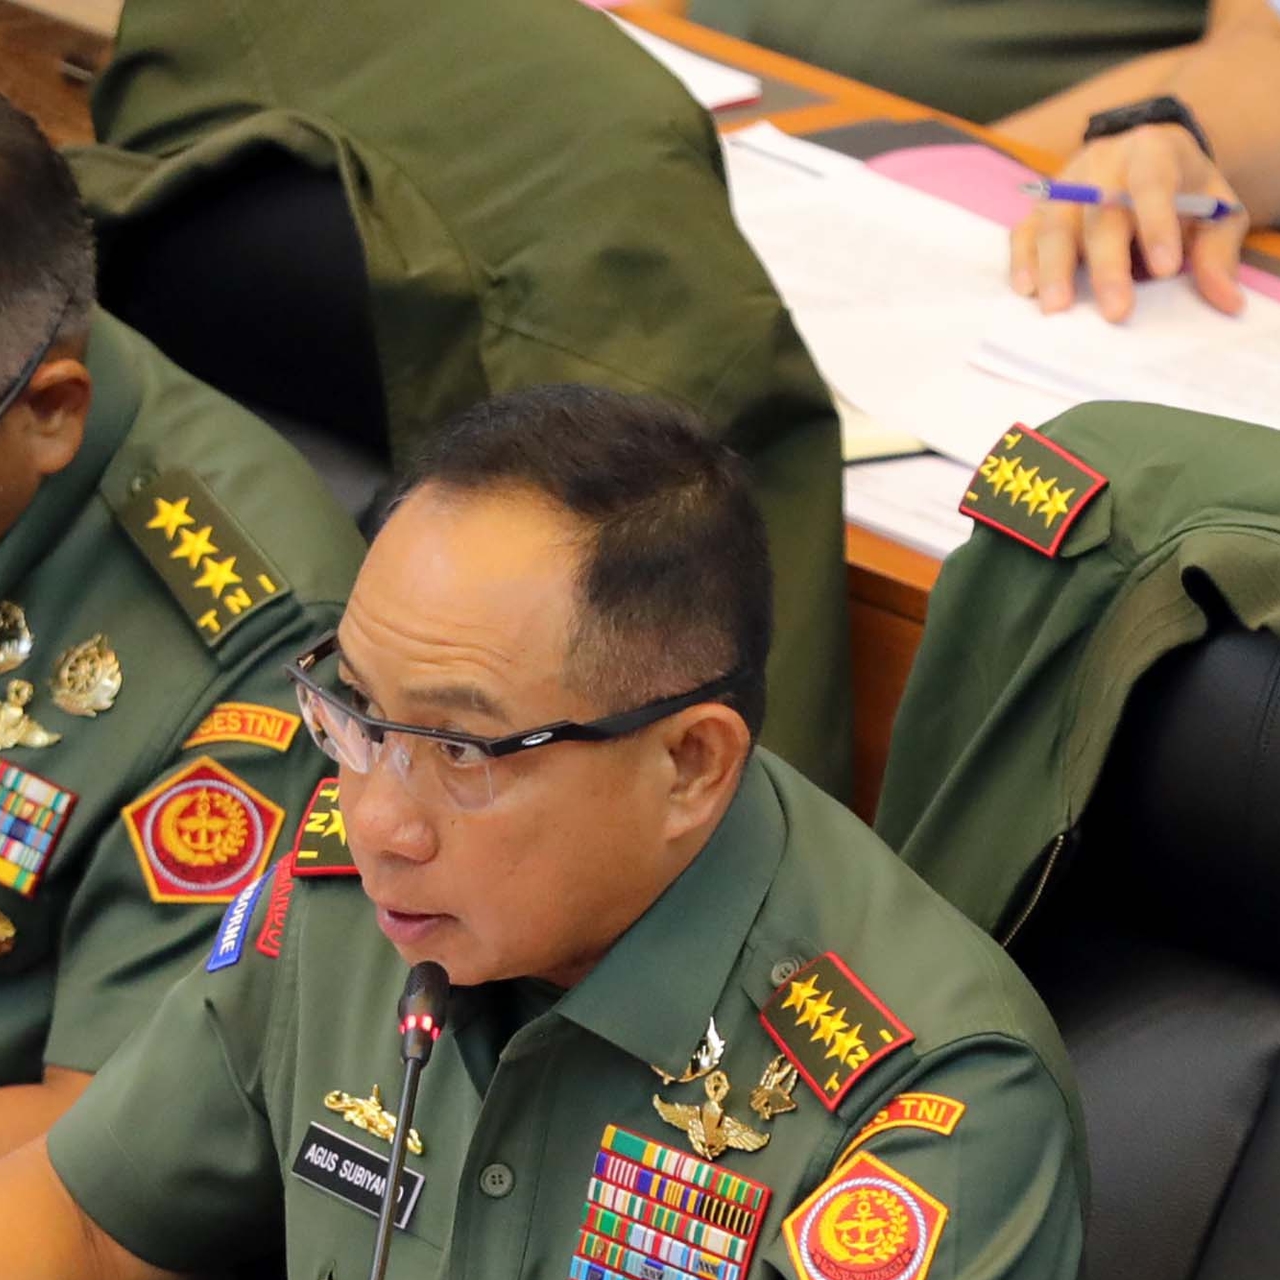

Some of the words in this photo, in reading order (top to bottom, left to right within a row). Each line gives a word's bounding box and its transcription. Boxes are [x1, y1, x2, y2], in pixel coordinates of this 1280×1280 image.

[197, 572, 277, 634] TNI
[243, 715, 283, 738] TNI
[823, 1027, 894, 1092] TNI
[900, 1097, 948, 1124] TNI
[304, 1143, 339, 1173] AGUS
